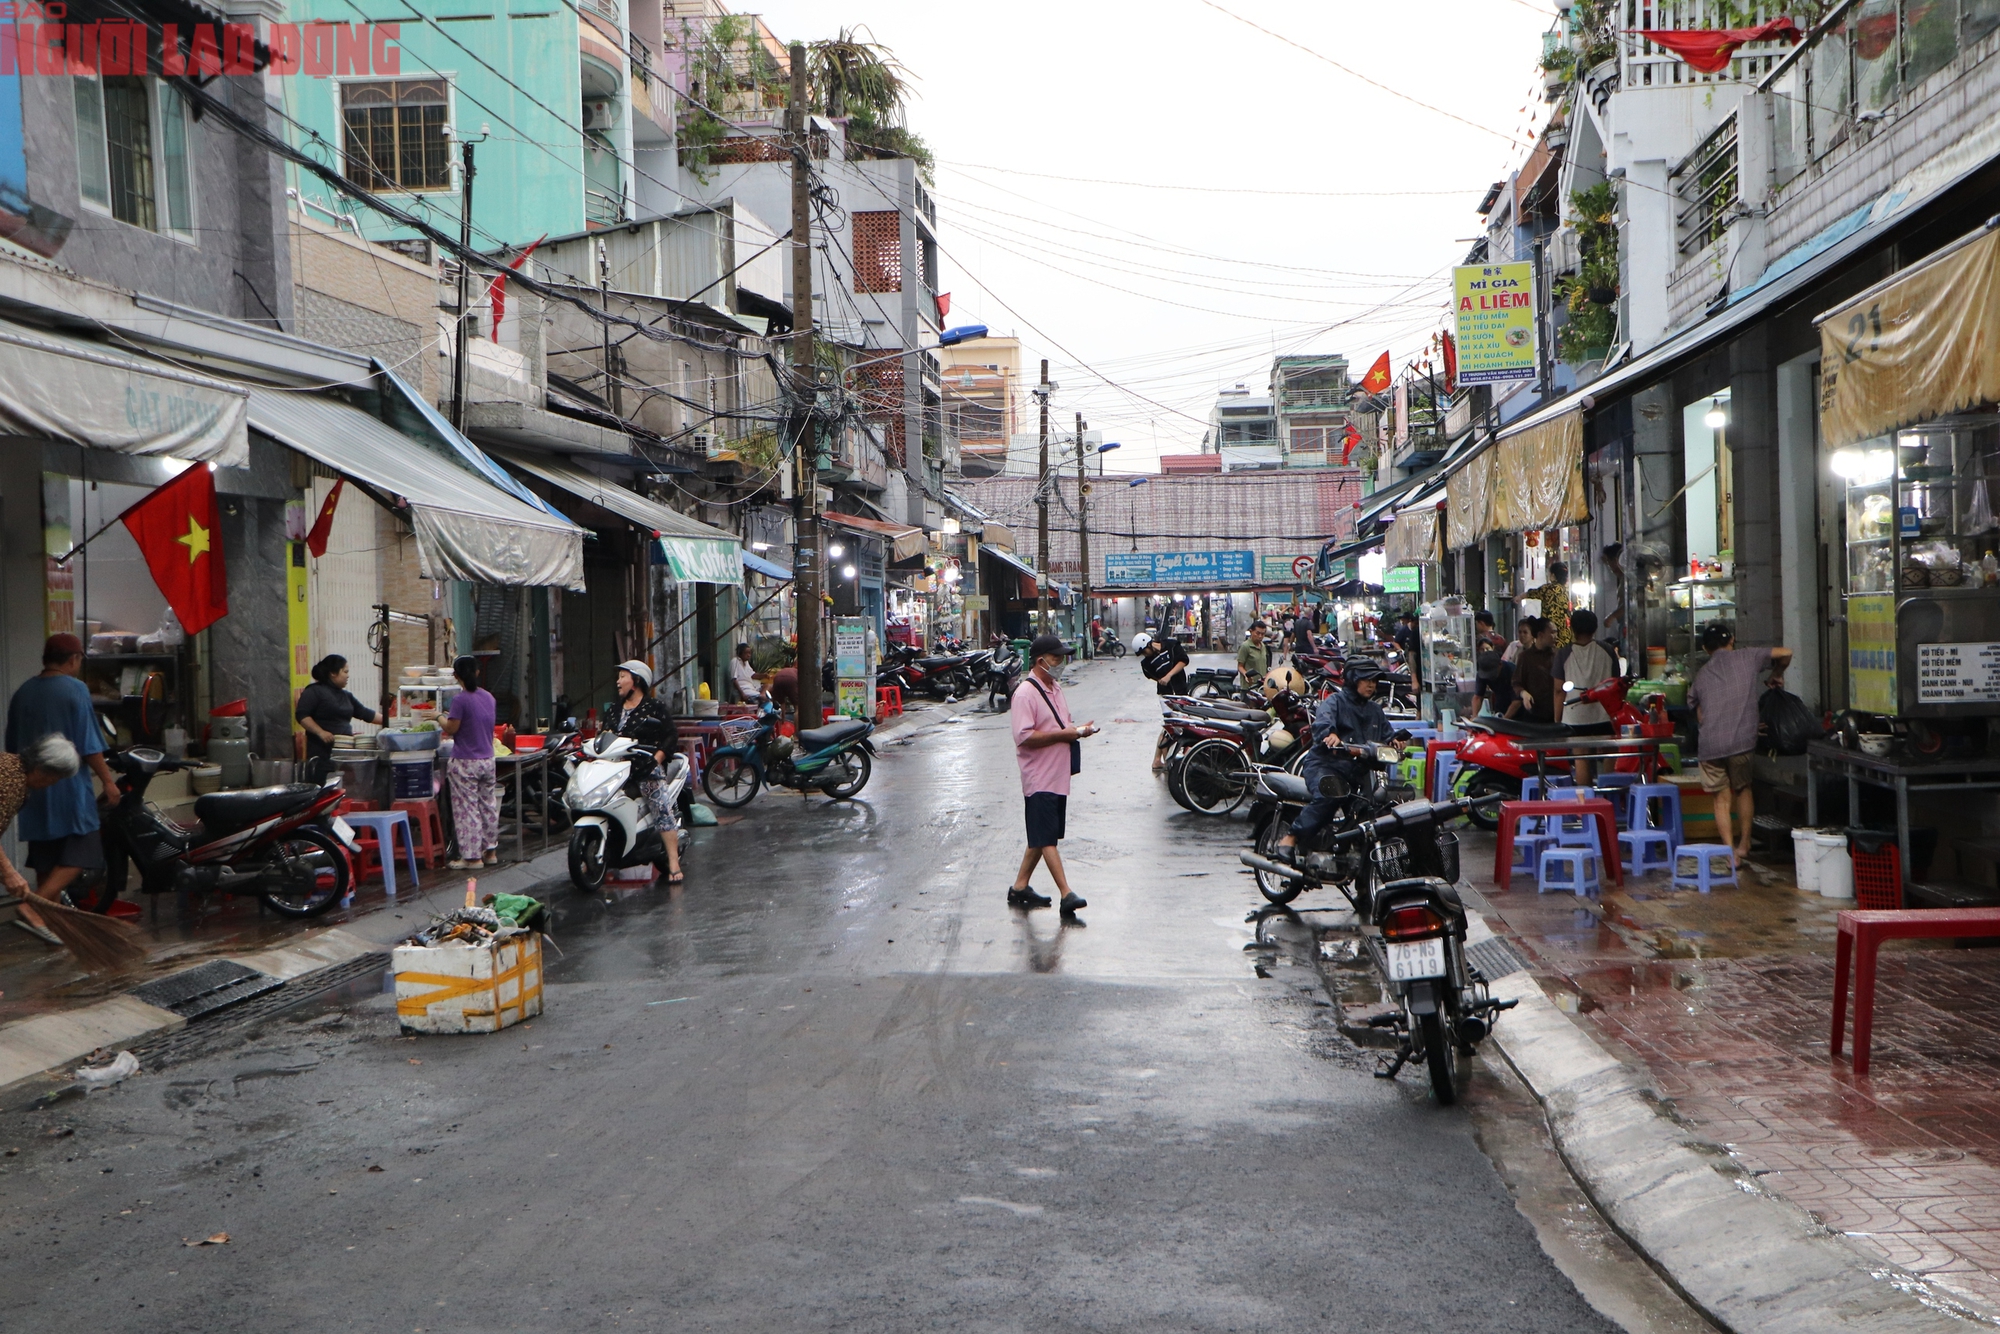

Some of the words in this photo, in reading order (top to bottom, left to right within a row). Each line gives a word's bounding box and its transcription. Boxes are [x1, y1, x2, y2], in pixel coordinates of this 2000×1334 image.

[1470, 279, 1487, 289] MÌ
[1492, 279, 1518, 288] GIA
[1460, 297, 1473, 311] A
[1480, 290, 1531, 311] LIÊM
[1844, 303, 1882, 365] 21
[1211, 553, 1217, 566] 1
[1921, 647, 1929, 656] HỦ
[1931, 647, 1944, 656] TIẾU
[1950, 647, 1958, 655] MÌ
[1921, 657, 1929, 666] HỦ
[1931, 657, 1944, 666] TIẾU
[1946, 657, 1961, 666] MỀM
[1921, 668, 1929, 677] HỦ
[1931, 668, 1944, 677] TIẾU
[1940, 679, 1957, 687] CANH
[1394, 941, 1435, 961] 76-N5
[1396, 958, 1438, 978] 6119
